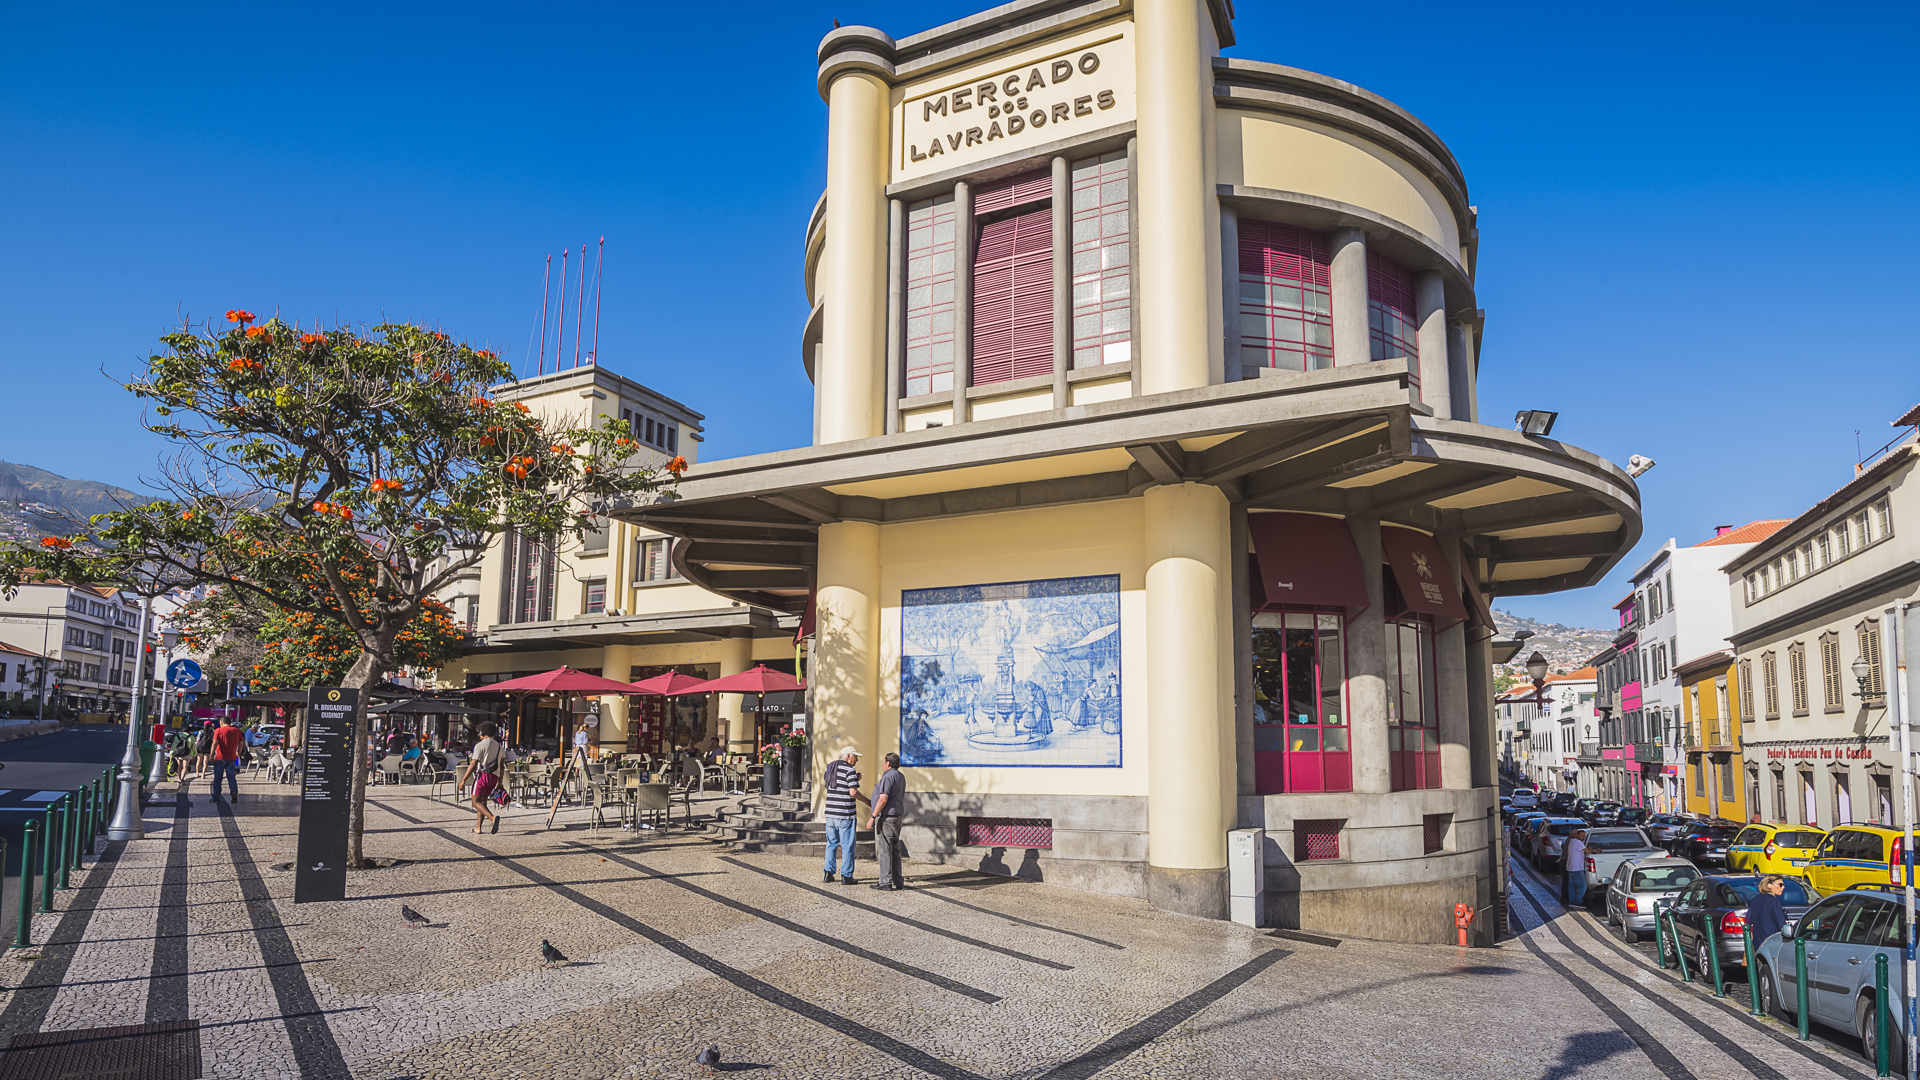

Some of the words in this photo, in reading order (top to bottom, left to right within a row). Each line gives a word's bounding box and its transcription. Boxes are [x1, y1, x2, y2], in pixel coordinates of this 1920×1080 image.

[923, 52, 1100, 122] MERCADO
[988, 96, 1029, 119] DOS
[910, 89, 1116, 163] LAVRADORES
[320, 704, 352, 712] BRIGADEIRO
[321, 711, 344, 719] OUDINOT
[1767, 747, 1787, 759] Padaria
[1788, 746, 1818, 759] Pastelaria
[1835, 746, 1843, 759] de
